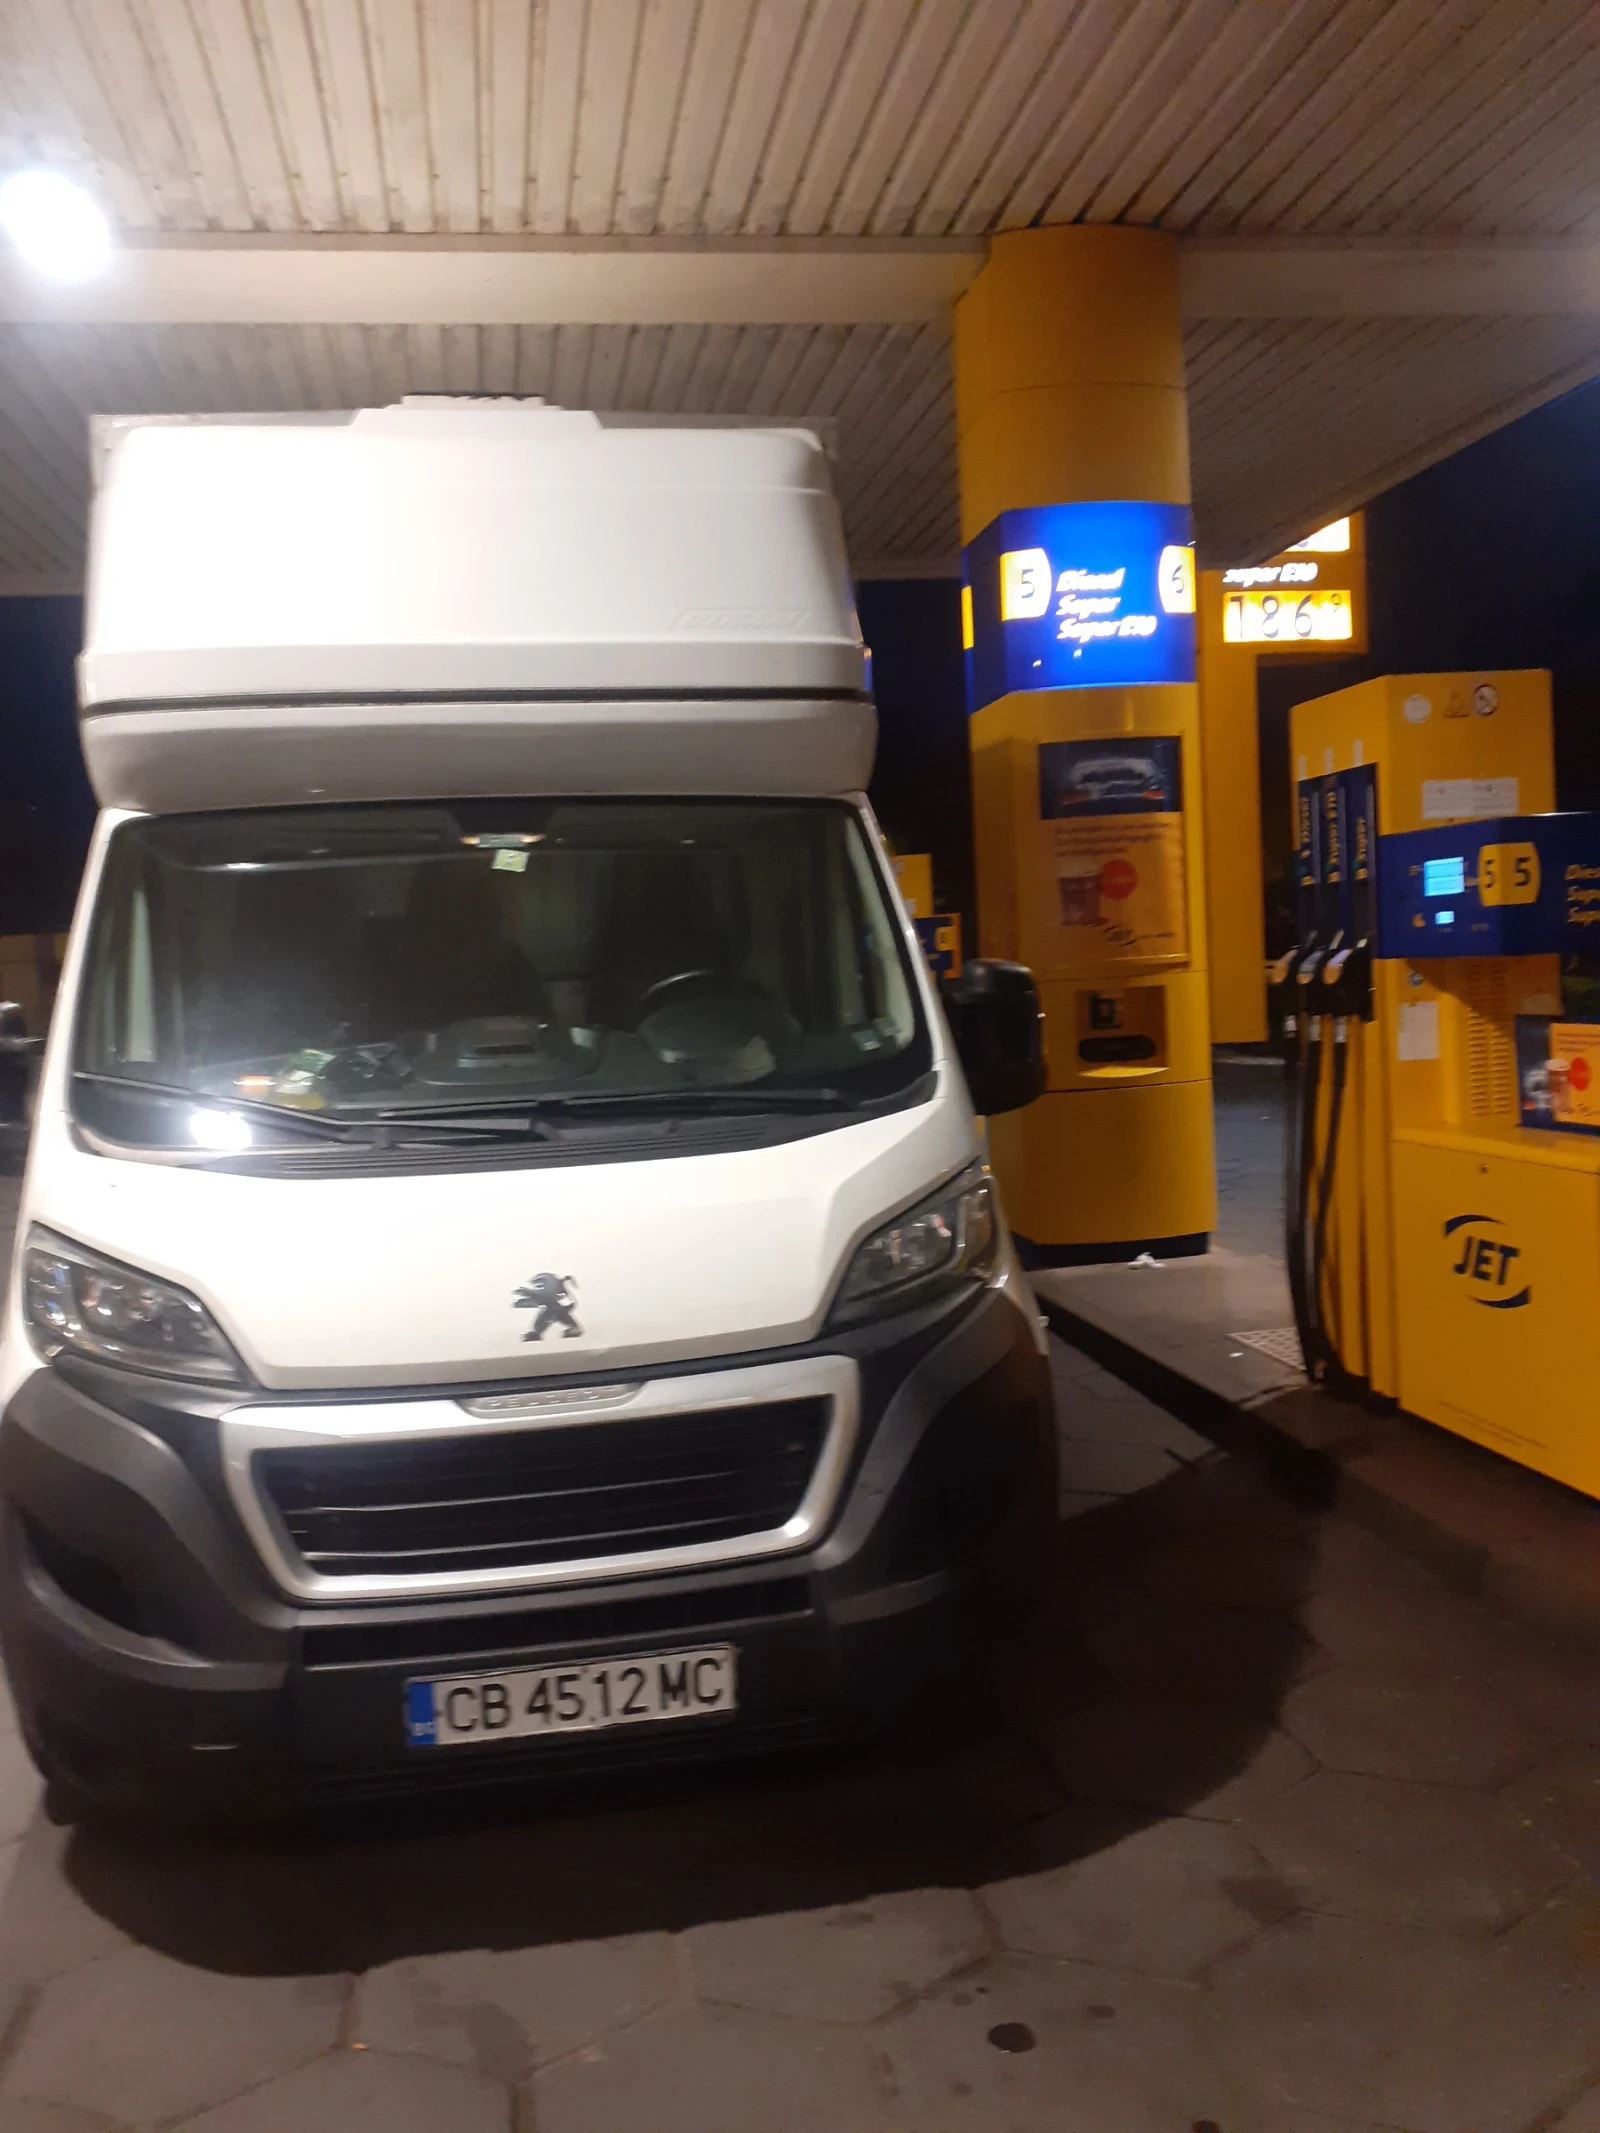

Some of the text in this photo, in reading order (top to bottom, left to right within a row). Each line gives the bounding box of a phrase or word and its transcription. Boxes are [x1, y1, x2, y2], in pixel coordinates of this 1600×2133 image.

[1021, 568, 1035, 598] 5
[1171, 564, 1185, 594] 6
[1056, 594, 1122, 620] Super
[1056, 614, 1157, 643] Super E10
[1485, 859, 1495, 888] 5
[1514, 856, 1531, 887] 5
[1453, 1236, 1521, 1286] JET
[446, 1657, 722, 1732] CB 4512 MC
